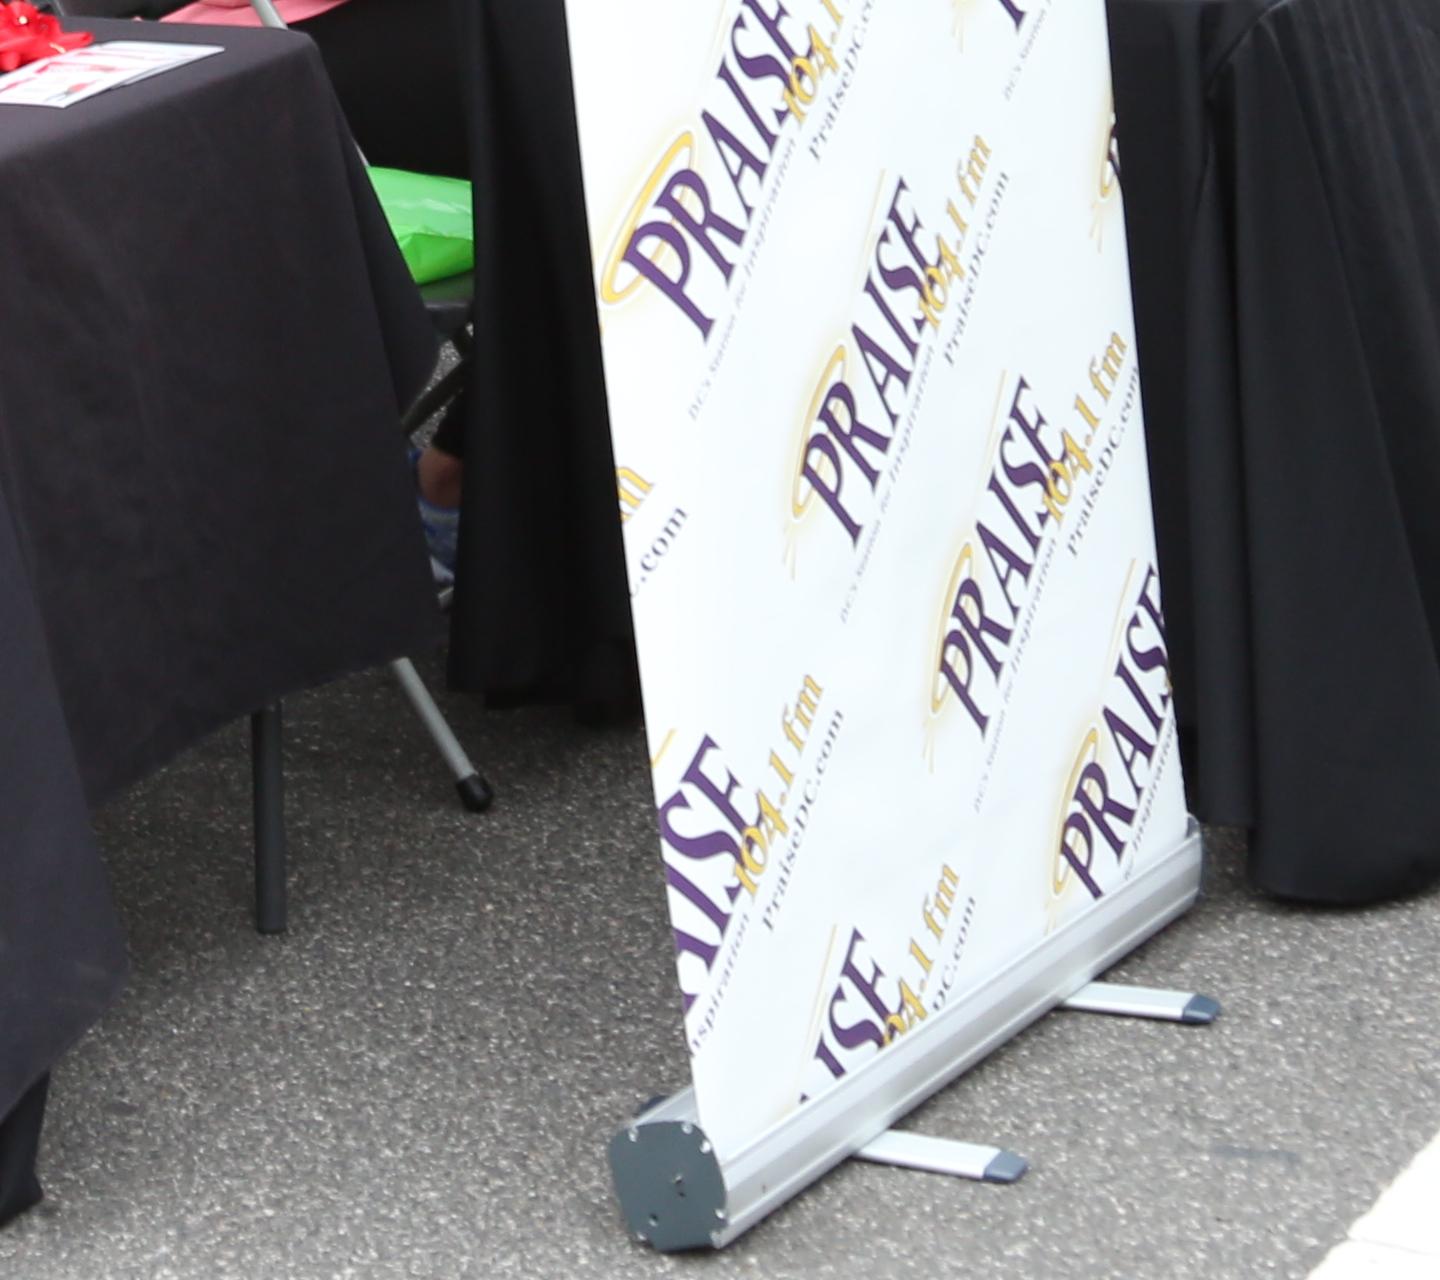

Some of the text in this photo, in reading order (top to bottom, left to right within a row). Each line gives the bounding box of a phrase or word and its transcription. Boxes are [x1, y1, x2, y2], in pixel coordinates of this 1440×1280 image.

[919, 137, 991, 328] 104.1 fm
[943, 172, 1009, 366] PraiseDC.com
[801, 177, 944, 547] PRAISE
[1043, 335, 1126, 521] 104.1 fm
[940, 376, 1066, 737] PRAISE
[734, 677, 822, 894] 104.1 fm
[762, 710, 844, 931] PraiseDC.com
[687, 913, 750, 1049] nspiration
[925, 867, 959, 937] fm
